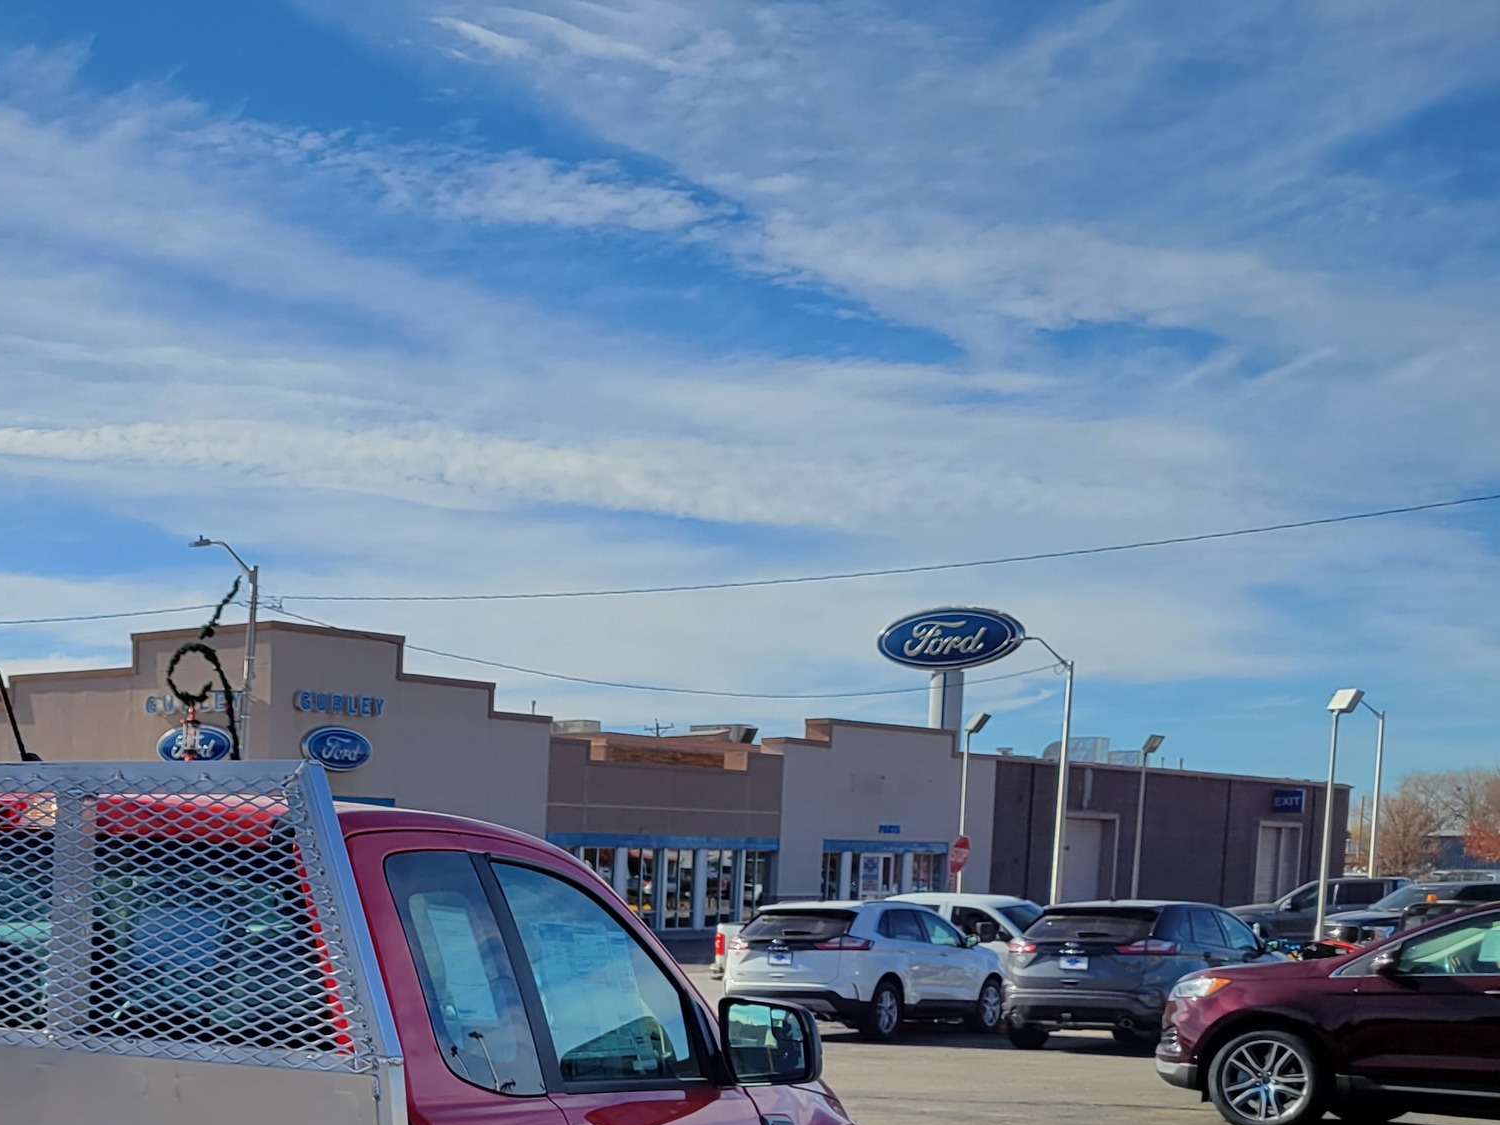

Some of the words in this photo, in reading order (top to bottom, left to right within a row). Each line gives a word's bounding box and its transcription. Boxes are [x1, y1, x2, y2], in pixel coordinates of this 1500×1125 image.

[903, 620, 987, 657] Ford
[299, 690, 385, 717] GURLEY
[322, 736, 363, 761] Ford
[1274, 797, 1301, 807] EXIT
